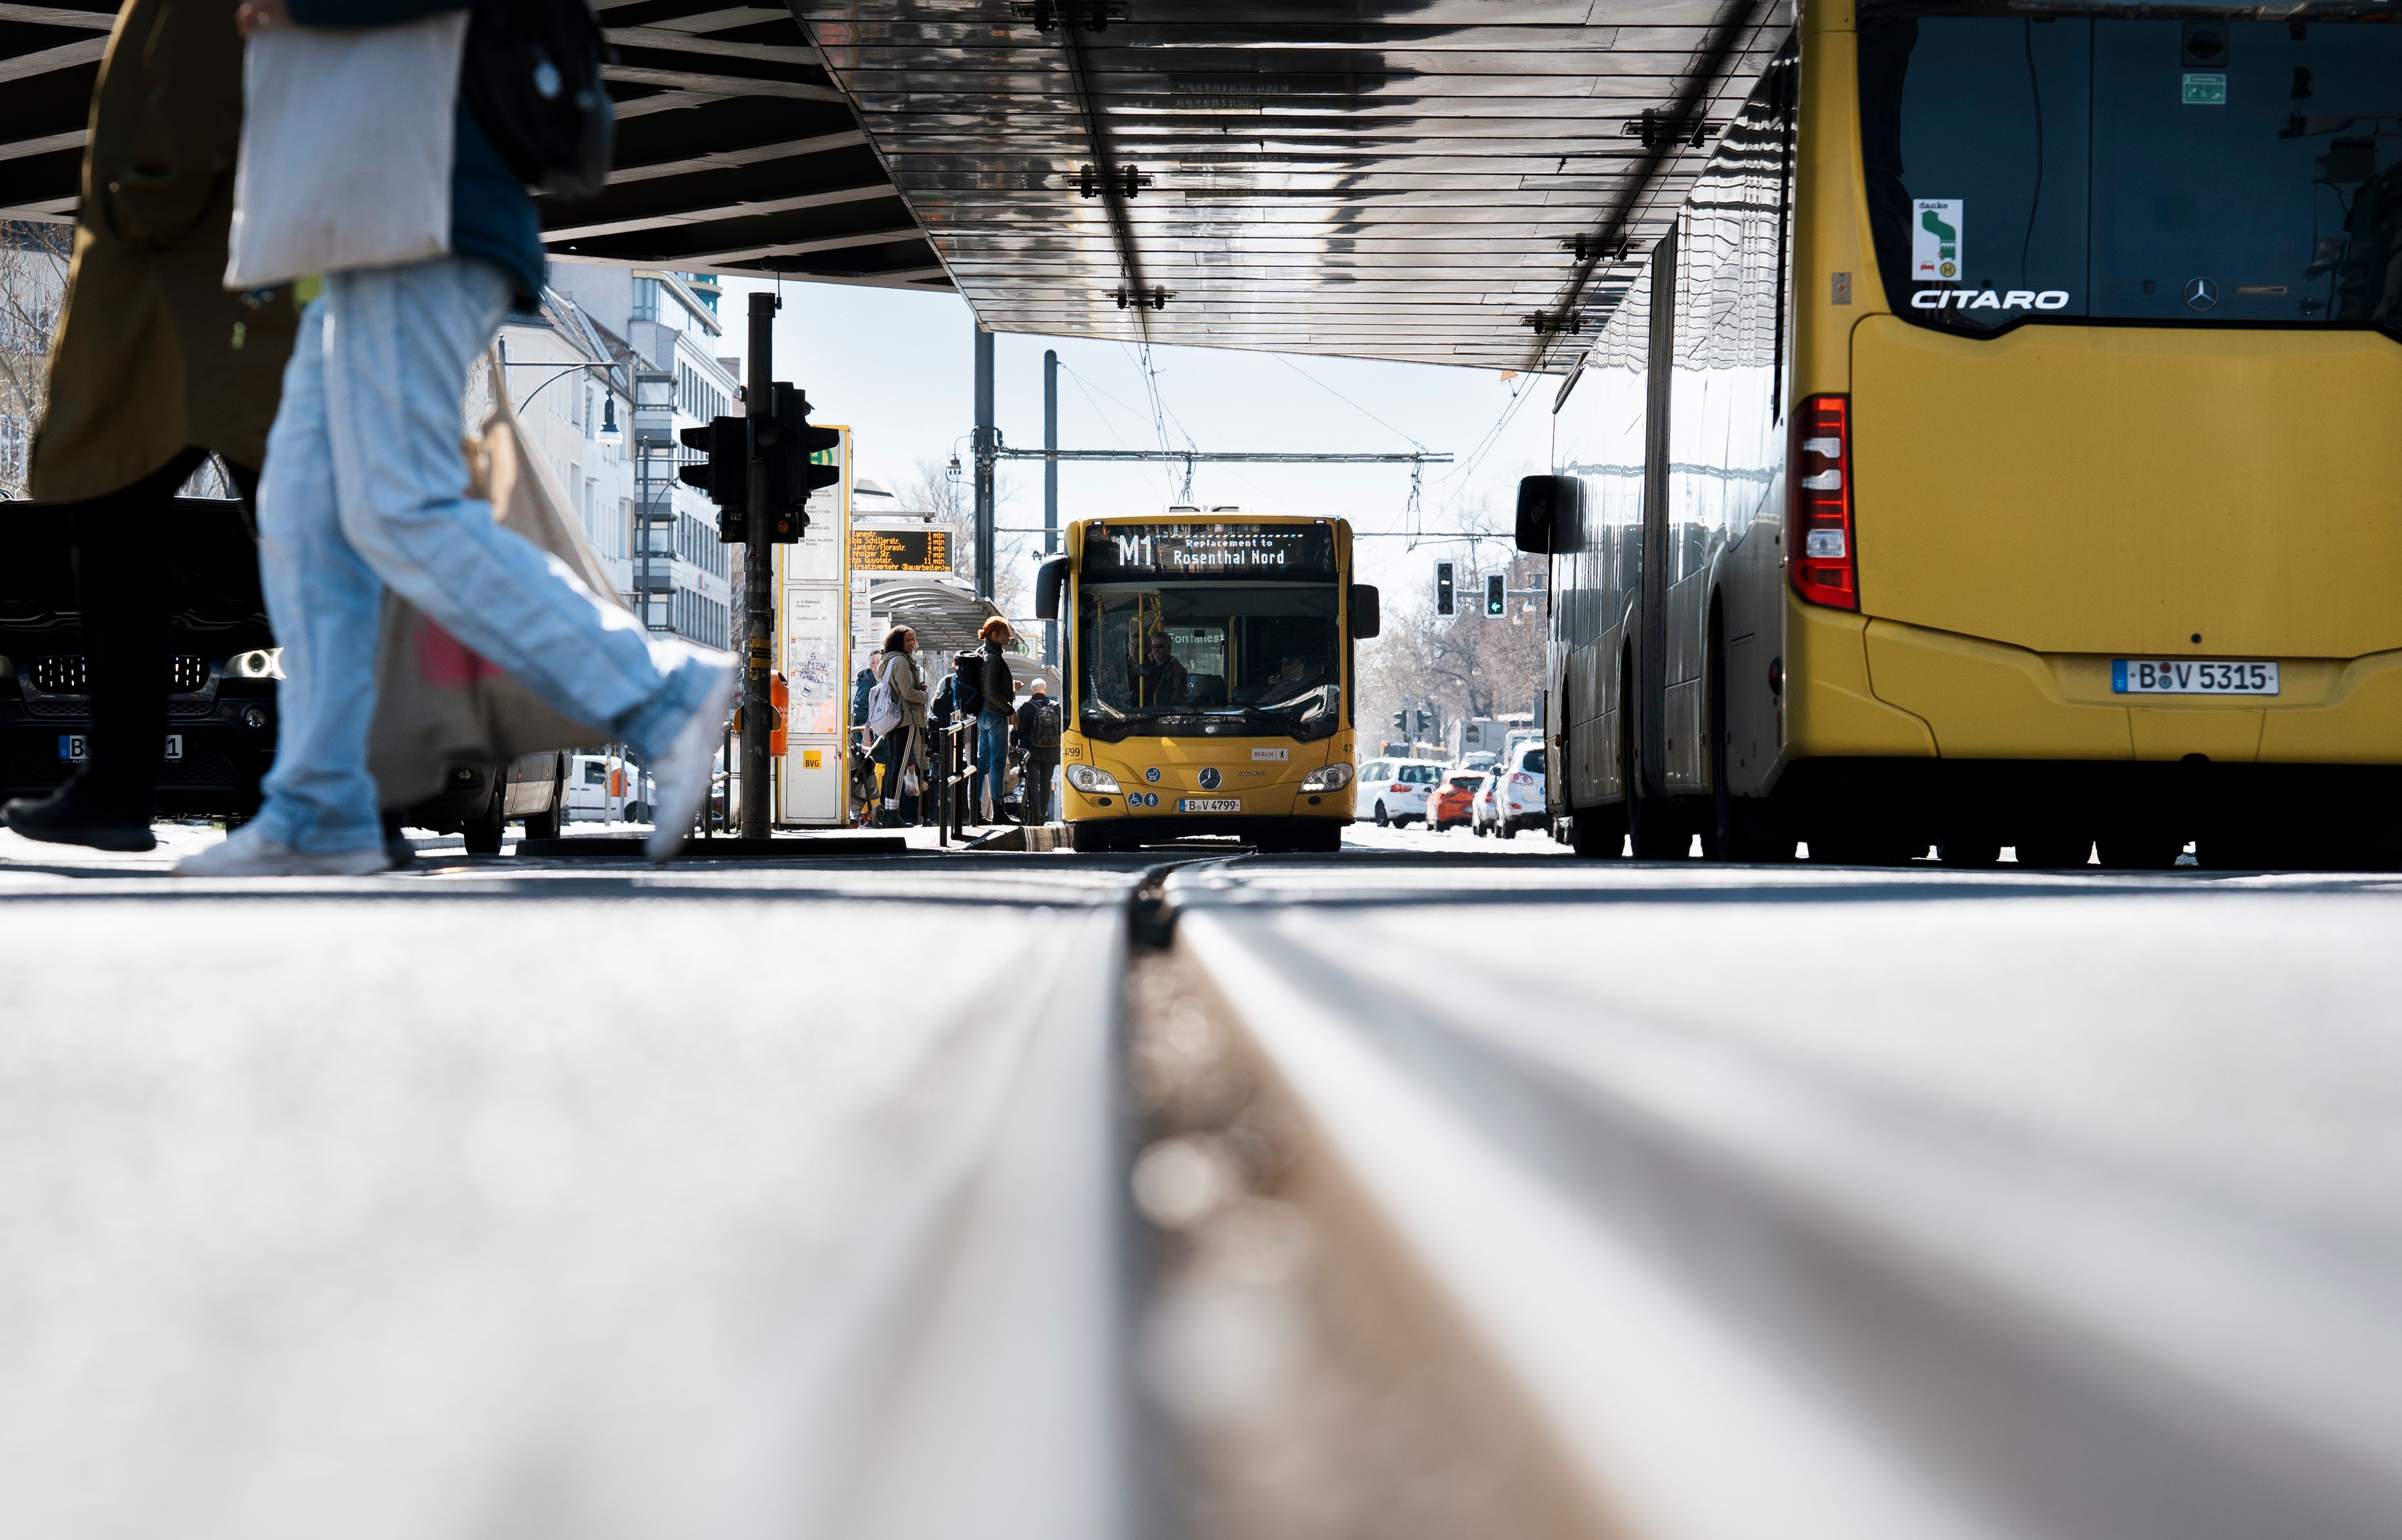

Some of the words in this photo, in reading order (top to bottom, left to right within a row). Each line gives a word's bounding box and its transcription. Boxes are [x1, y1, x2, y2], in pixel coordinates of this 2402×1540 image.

[1911, 290, 2069, 309] CITARO
[1119, 535, 1151, 566] M1
[1174, 550, 1245, 564] Rosenthal
[1252, 550, 1284, 564] Nord
[2140, 664, 2155, 688] B
[2176, 664, 2191, 689] V
[2199, 665, 2266, 690] 5315
[72, 738, 84, 757] B
[167, 738, 179, 756] 1
[1065, 747, 1080, 757] 4799
[1189, 801, 1196, 810] B
[1203, 801, 1209, 810] V
[1211, 801, 1236, 810] 4799
